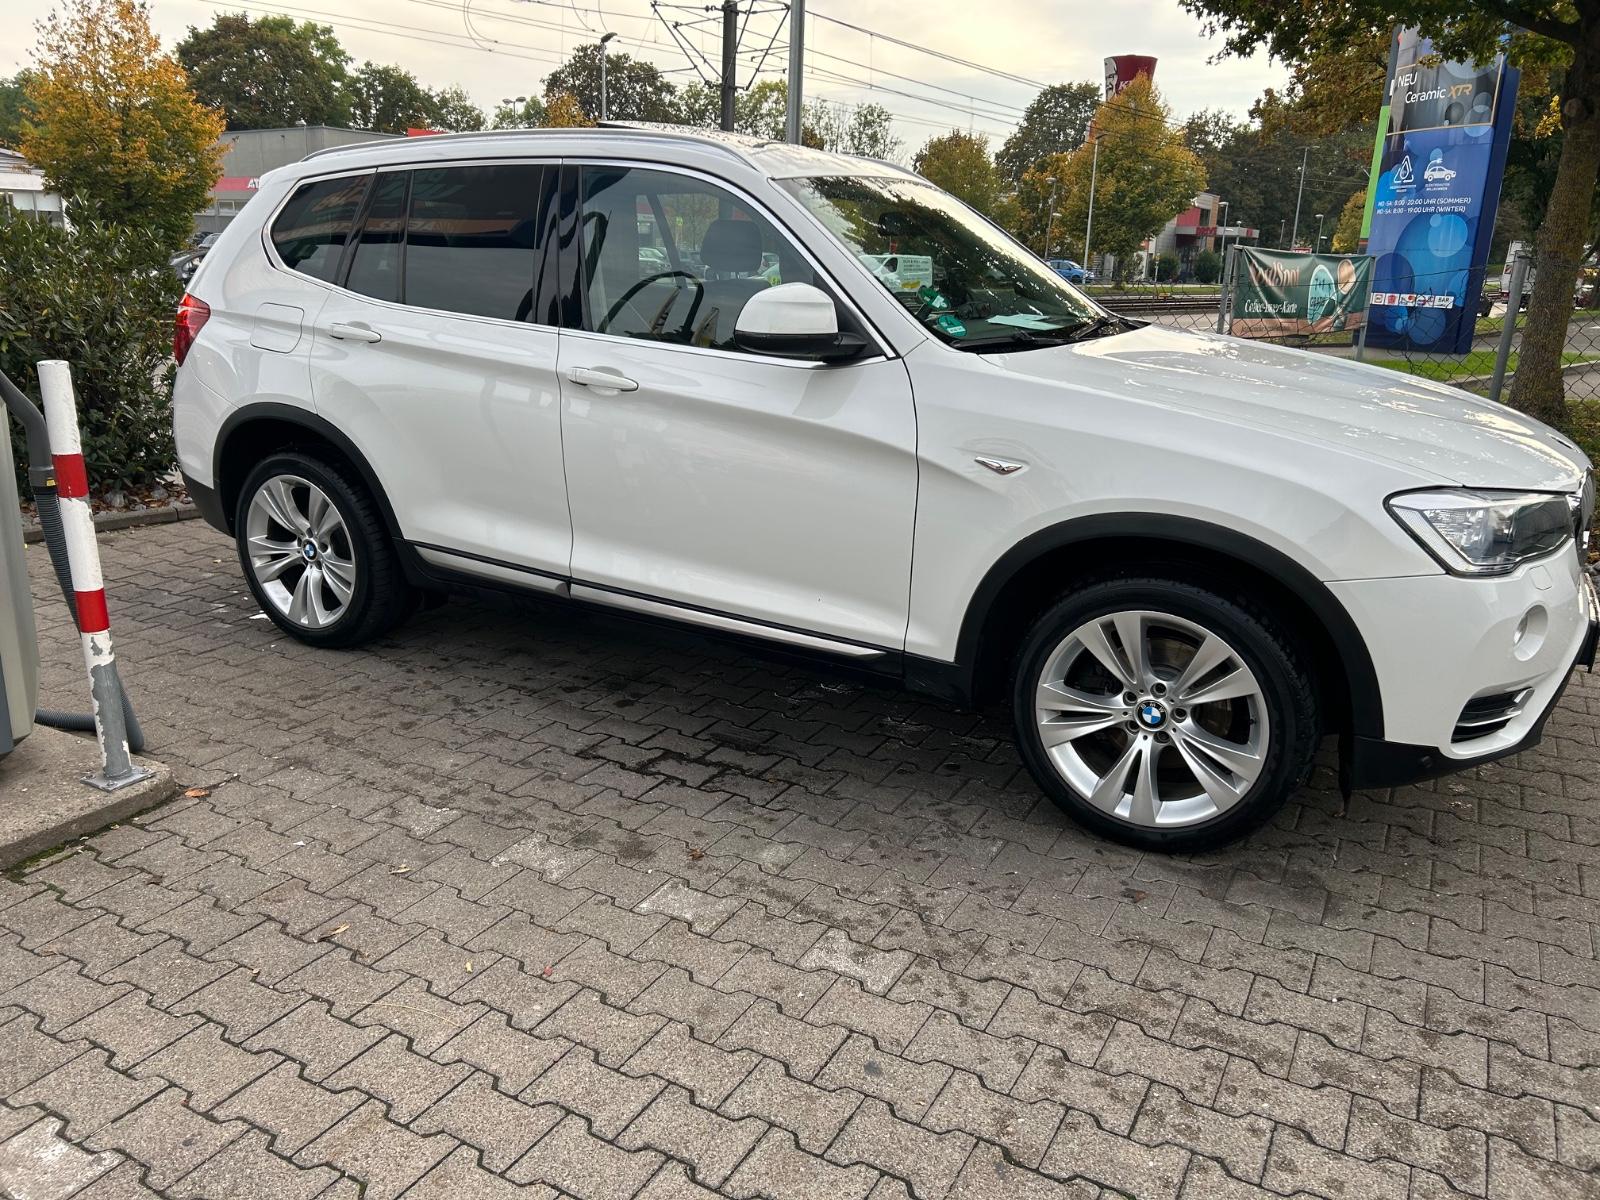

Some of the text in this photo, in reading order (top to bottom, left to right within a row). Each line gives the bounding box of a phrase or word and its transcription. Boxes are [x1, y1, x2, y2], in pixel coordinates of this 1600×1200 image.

[1398, 72, 1418, 88] NEU
[1405, 83, 1473, 104] Ceramic XTR
[1436, 196, 1472, 205] (SOMMER)
[1435, 205, 1466, 213] (WINTER)
